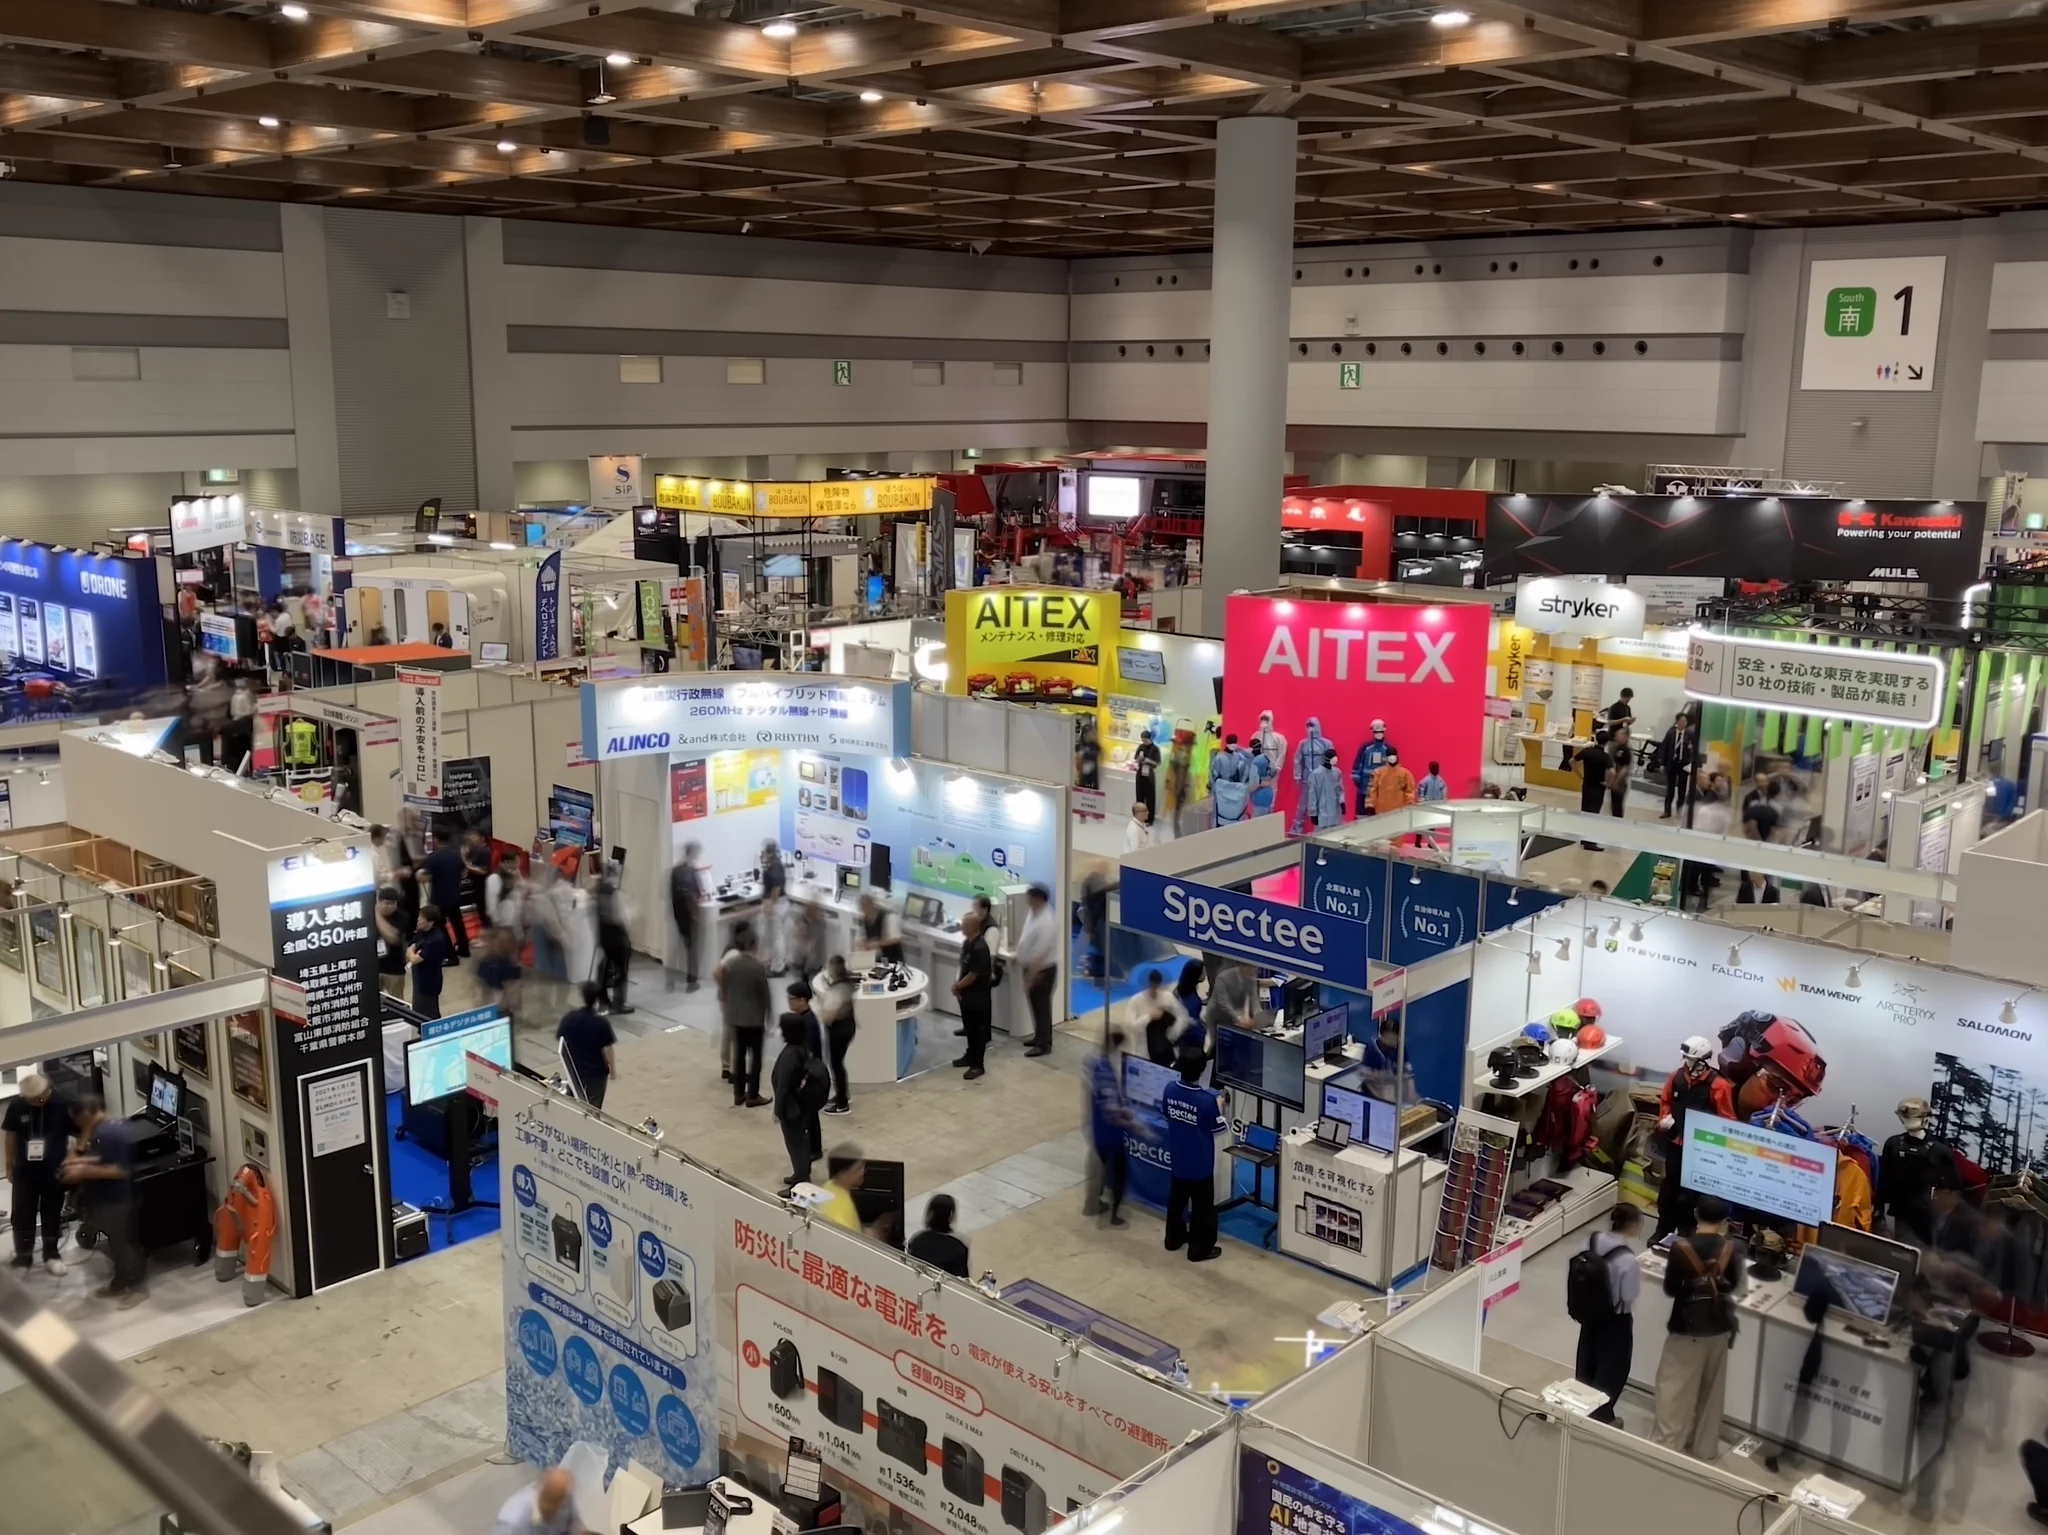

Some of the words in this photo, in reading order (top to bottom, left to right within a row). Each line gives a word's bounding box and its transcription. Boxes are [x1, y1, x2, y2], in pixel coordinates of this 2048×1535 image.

[1838, 292, 1865, 304] South
[1837, 305, 1862, 333] 南
[1893, 285, 1914, 337] 1
[712, 494, 752, 511] BOUBAKUN
[768, 494, 808, 505] BOUBAKUN
[823, 487, 850, 498] 危険物
[876, 491, 921, 508] BOUBAKUN
[815, 500, 857, 511] 保管庫なら
[1836, 527, 1885, 539] Powering
[1887, 529, 1911, 540] your
[1913, 528, 1962, 540] potential
[1868, 567, 1920, 579] MULE
[974, 595, 1091, 631] AITEX
[1538, 594, 1620, 619] stryker
[980, 630, 1085, 645] メンテナンス・修理対応
[1257, 624, 1457, 684] AITEX
[1505, 634, 1522, 691] stryker
[1737, 656, 1930, 691] 安全・安心な東京を実現する
[689, 706, 743, 717] 260MHz
[415, 686, 426, 782] 導入前の不安をゼロに
[606, 731, 671, 754] ALINCO
[774, 732, 820, 743] RHYTHM
[443, 779, 478, 790] Firefighters
[449, 772, 473, 781] Helping
[443, 789, 459, 798] Fight
[459, 786, 480, 796] Cancer
[1325, 882, 1361, 898] 企業導入数
[286, 900, 363, 932] 導入実績
[1325, 895, 1359, 917] No.1
[1162, 883, 1325, 955] Spectee
[1414, 916, 1450, 939] No.1
[282, 926, 369, 955] 全国350件超
[1799, 983, 1826, 997] TEAM
[1827, 987, 1862, 1004] WENDY
[1893, 1012, 1917, 1027] PRO
[1956, 1017, 2033, 1042] SALOMON
[1167, 1105, 1198, 1123] Spectee
[514, 1111, 694, 1211] インラがない場所に「水」と「熱症対策」を。
[515, 1171, 535, 1195] 導入
[1291, 1158, 1375, 1196] 「危機」を可視化する
[589, 1209, 610, 1235] 導入
[641, 1242, 663, 1264] 導入
[734, 1218, 960, 1356] 防災に最適な電源を。
[746, 1346, 757, 1361] 小
[910, 1362, 967, 1403] 容量の目安
[945, 1411, 963, 1427] DELTA
[969, 1426, 984, 1438] MAX
[1009, 1447, 1029, 1463] DELTA
[1036, 1462, 1046, 1474] Pro
[1269, 1502, 1290, 1526] AI
[1271, 1488, 1346, 1535] 国民の命を守る
